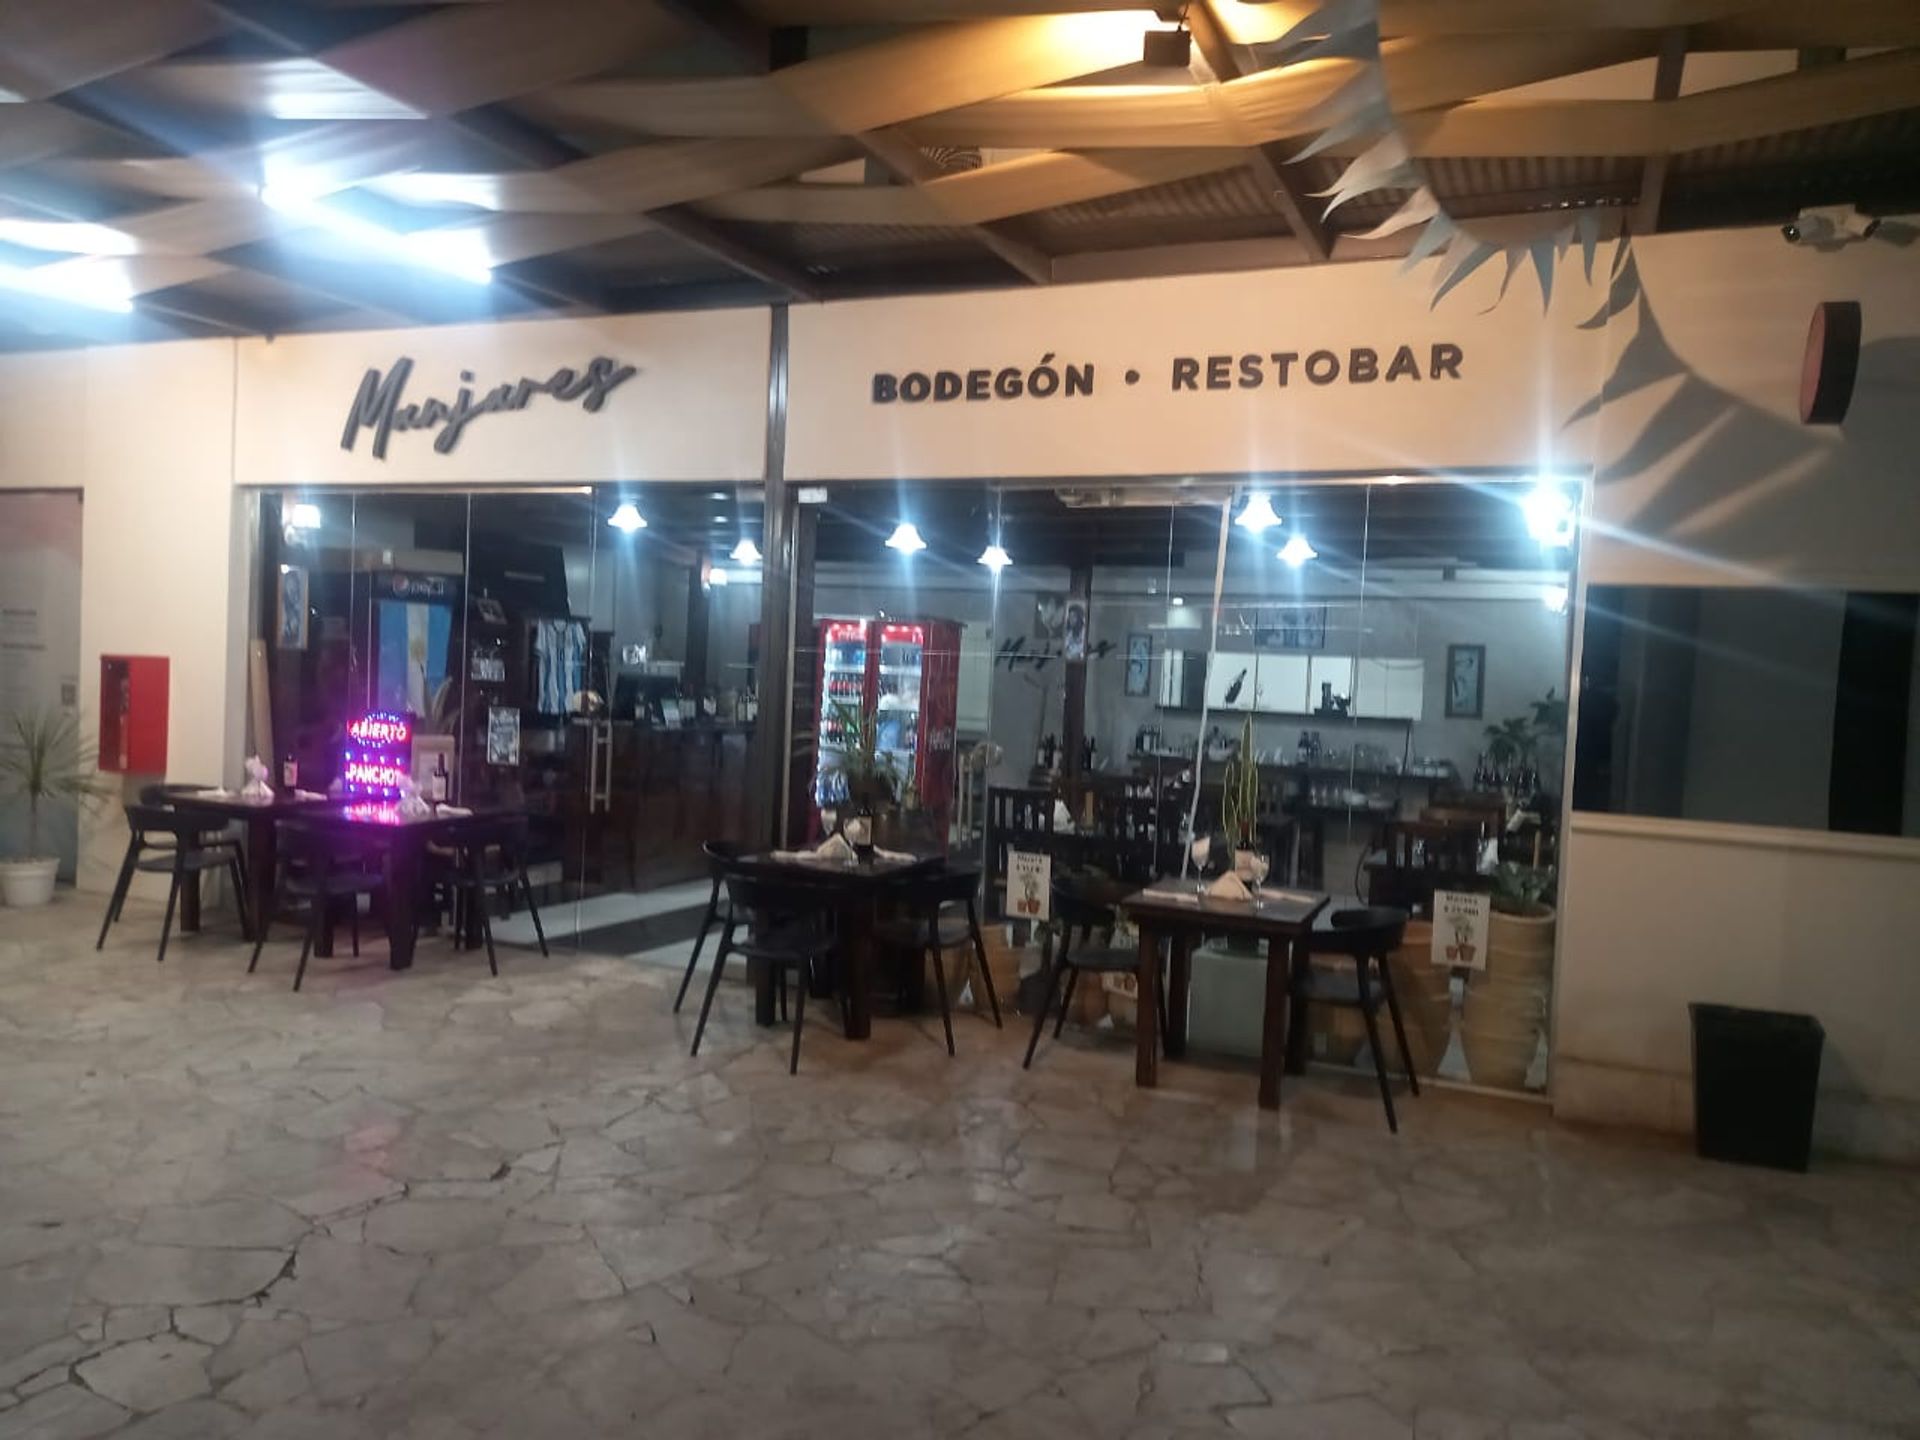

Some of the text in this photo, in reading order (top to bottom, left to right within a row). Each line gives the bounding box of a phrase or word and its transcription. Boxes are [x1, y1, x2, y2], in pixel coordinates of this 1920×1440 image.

[872, 342, 1466, 403] BODEGÓN RESTOBAR
[341, 356, 637, 460] Manjares
[351, 720, 407, 741] ABIERTO
